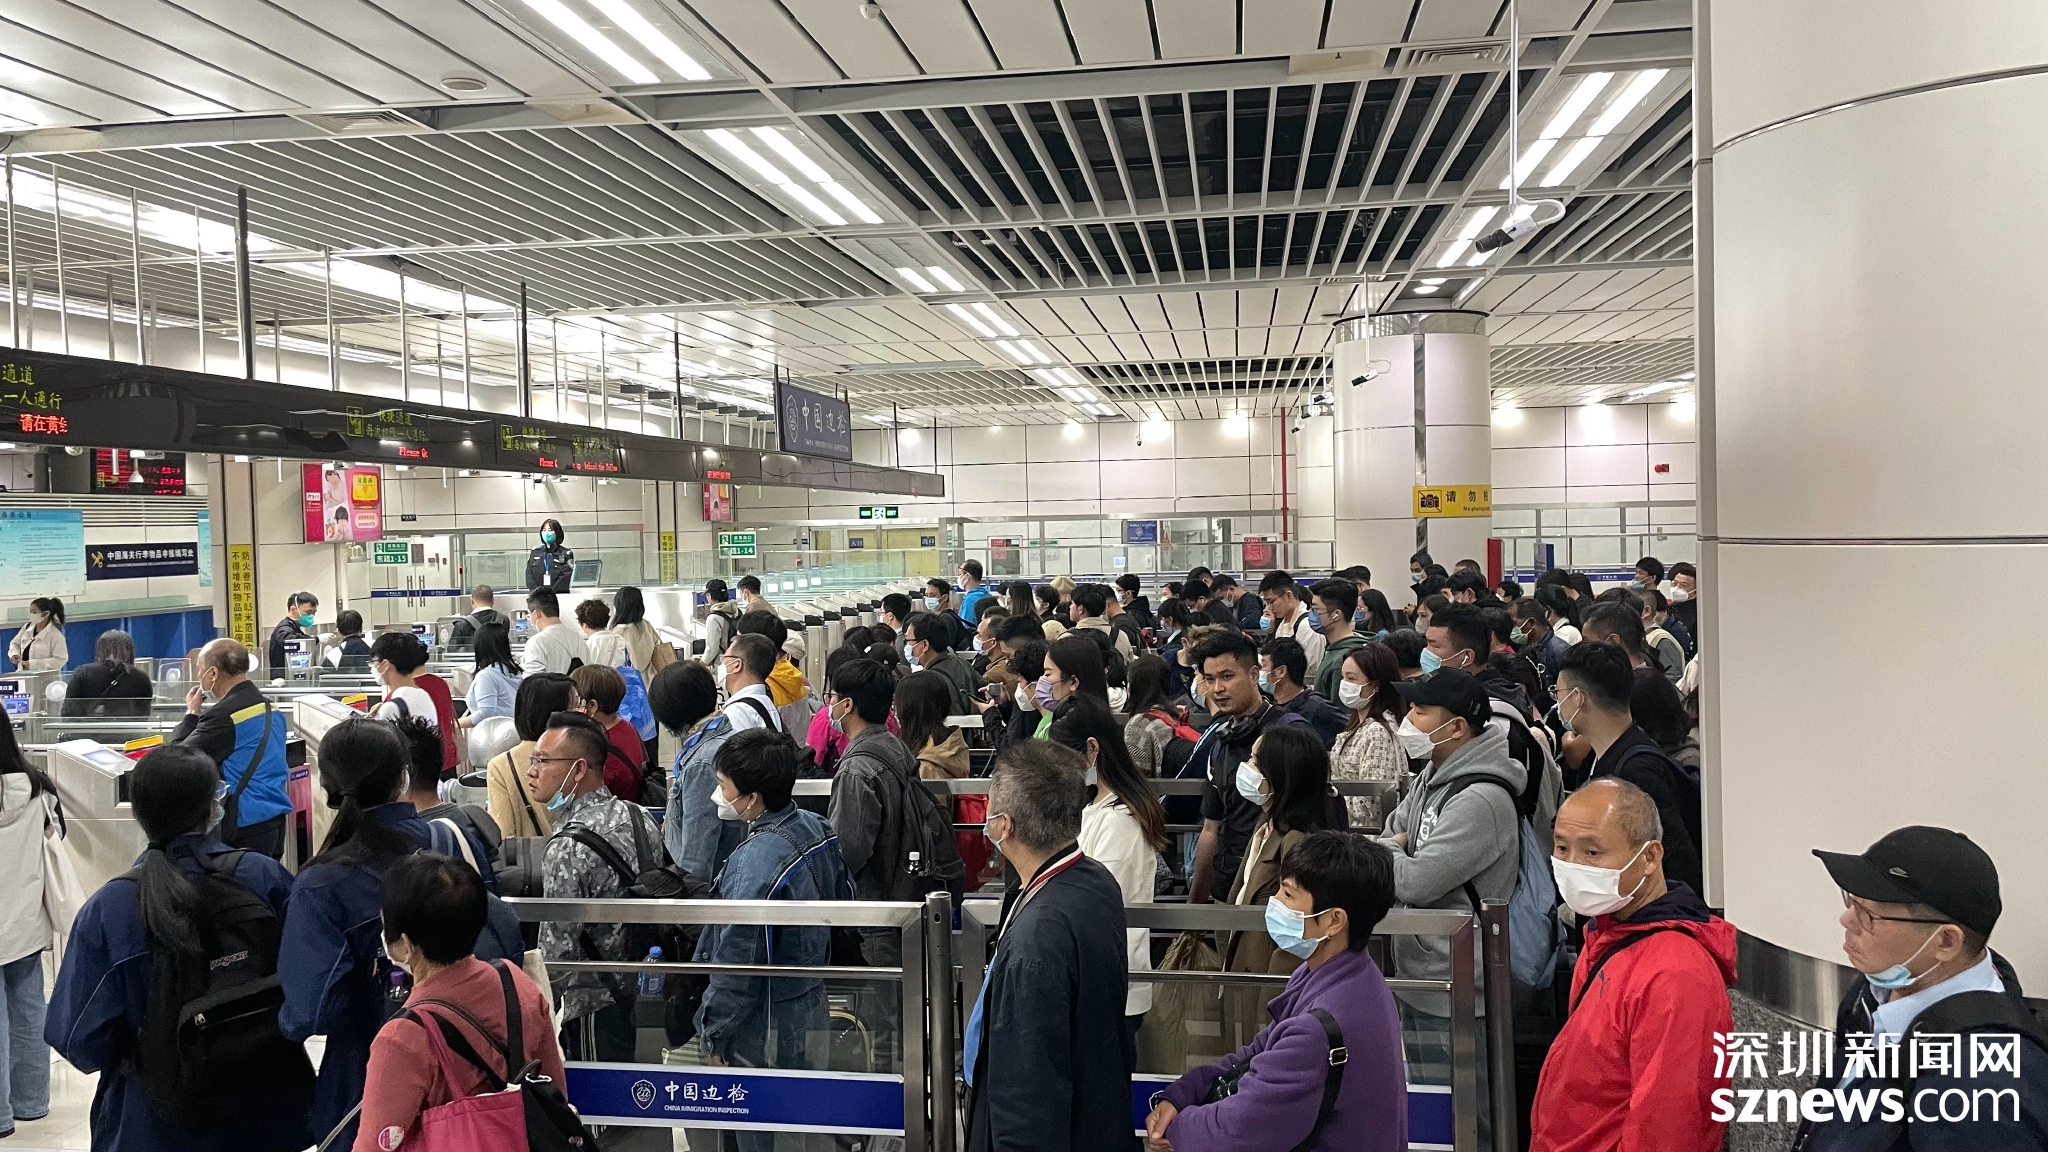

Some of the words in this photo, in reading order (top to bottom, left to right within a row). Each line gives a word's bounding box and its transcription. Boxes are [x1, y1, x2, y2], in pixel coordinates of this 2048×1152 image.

[2, 363, 35, 386] 通道
[802, 398, 847, 438] 中国边检
[399, 446, 419, 457] Please
[664, 1080, 749, 1104] 中国边检
[664, 1104, 680, 1112] CHINA
[680, 1105, 718, 1114] IMMIGRATION
[718, 1106, 749, 1115] INSPECTION
